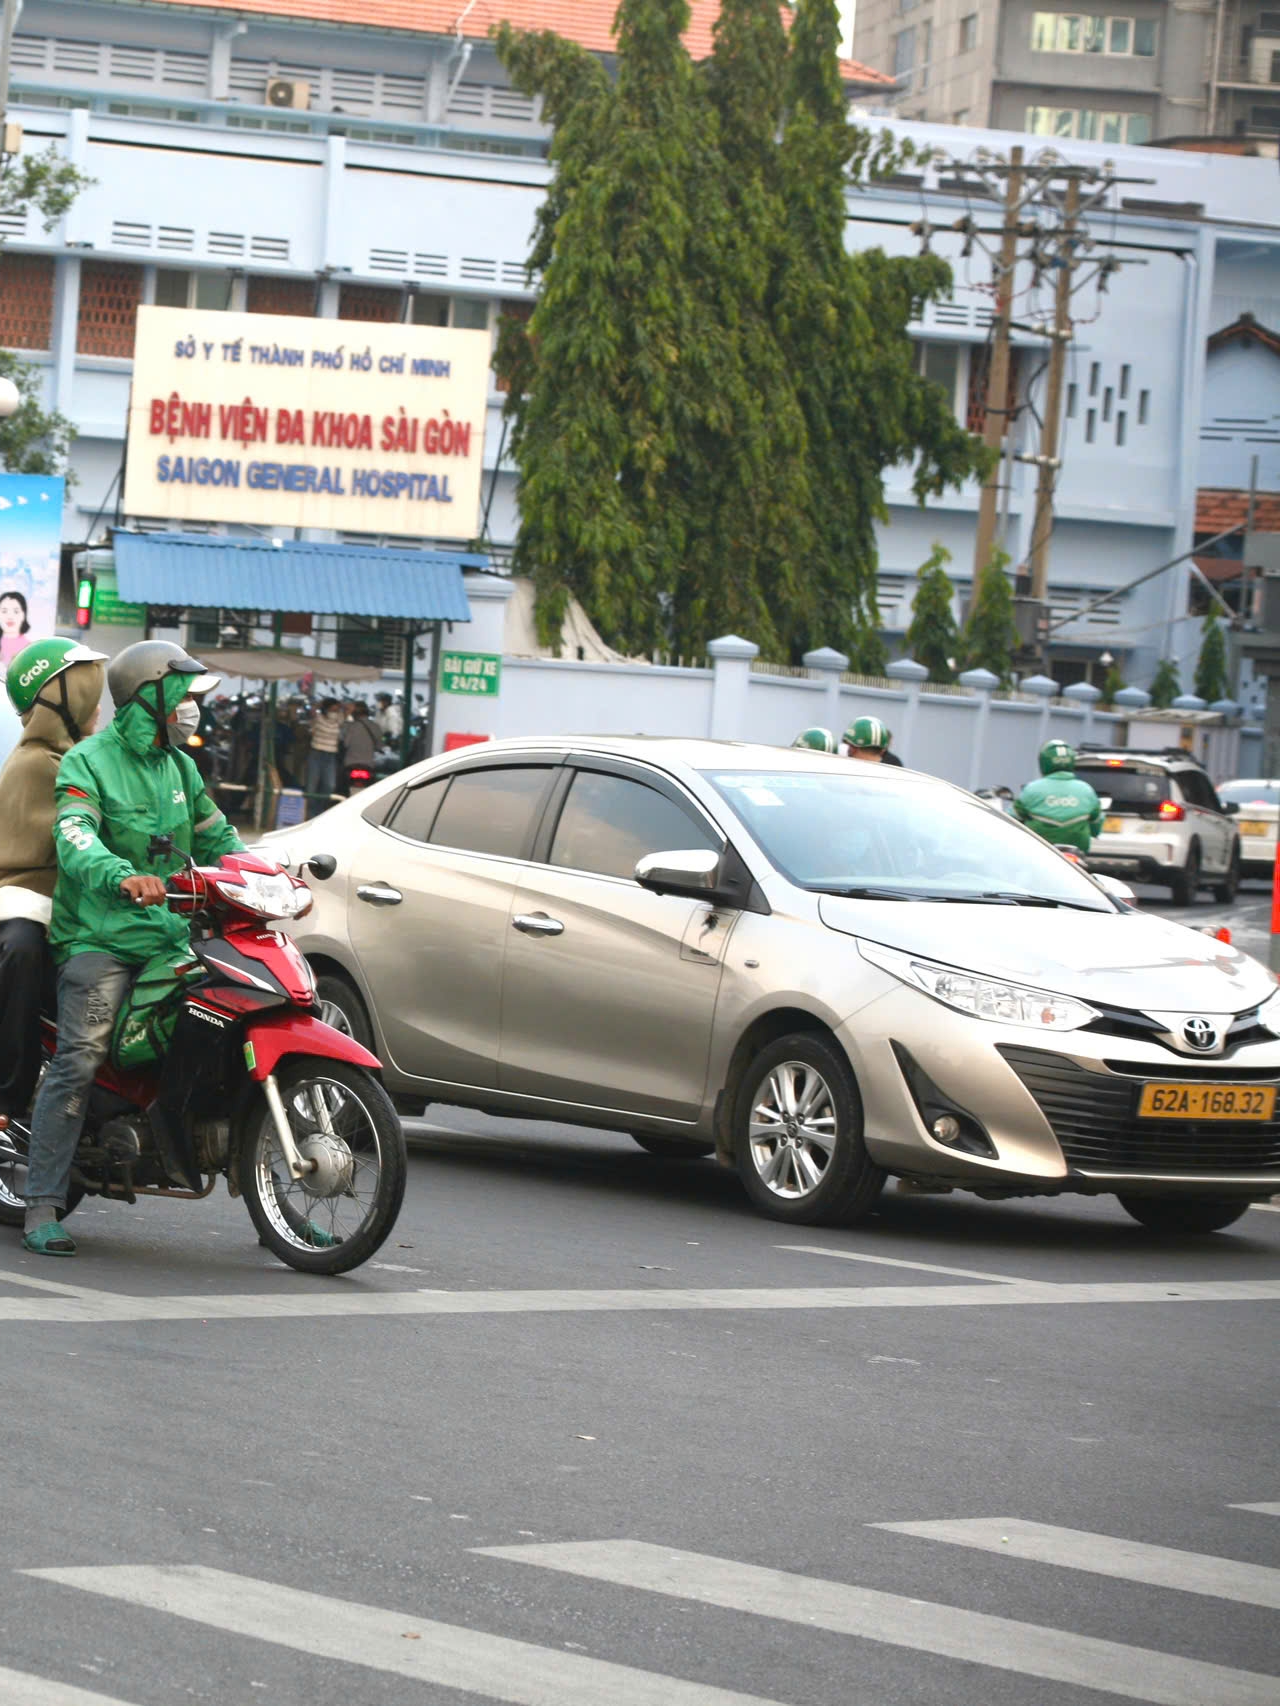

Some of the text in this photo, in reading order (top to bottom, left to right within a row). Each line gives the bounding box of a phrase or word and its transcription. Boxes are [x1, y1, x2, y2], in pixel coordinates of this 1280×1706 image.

[175, 334, 196, 359] SỞ
[202, 342, 214, 361] Y
[222, 337, 243, 362] TẾ
[250, 342, 304, 367] THÀNH
[311, 345, 345, 370] PHỐ
[378, 353, 406, 374] CHÍ
[410, 358, 451, 378] MINH
[150, 391, 470, 457] BỆNH VIỆN ĐA KHOA SÀI GÒN
[157, 455, 452, 503] SAIGON GENERAL HOSPITAL
[19, 658, 50, 687] Grab
[451, 675, 487, 692] 24/24
[1045, 794, 1080, 808] Grab
[188, 1006, 225, 1029] HONDA
